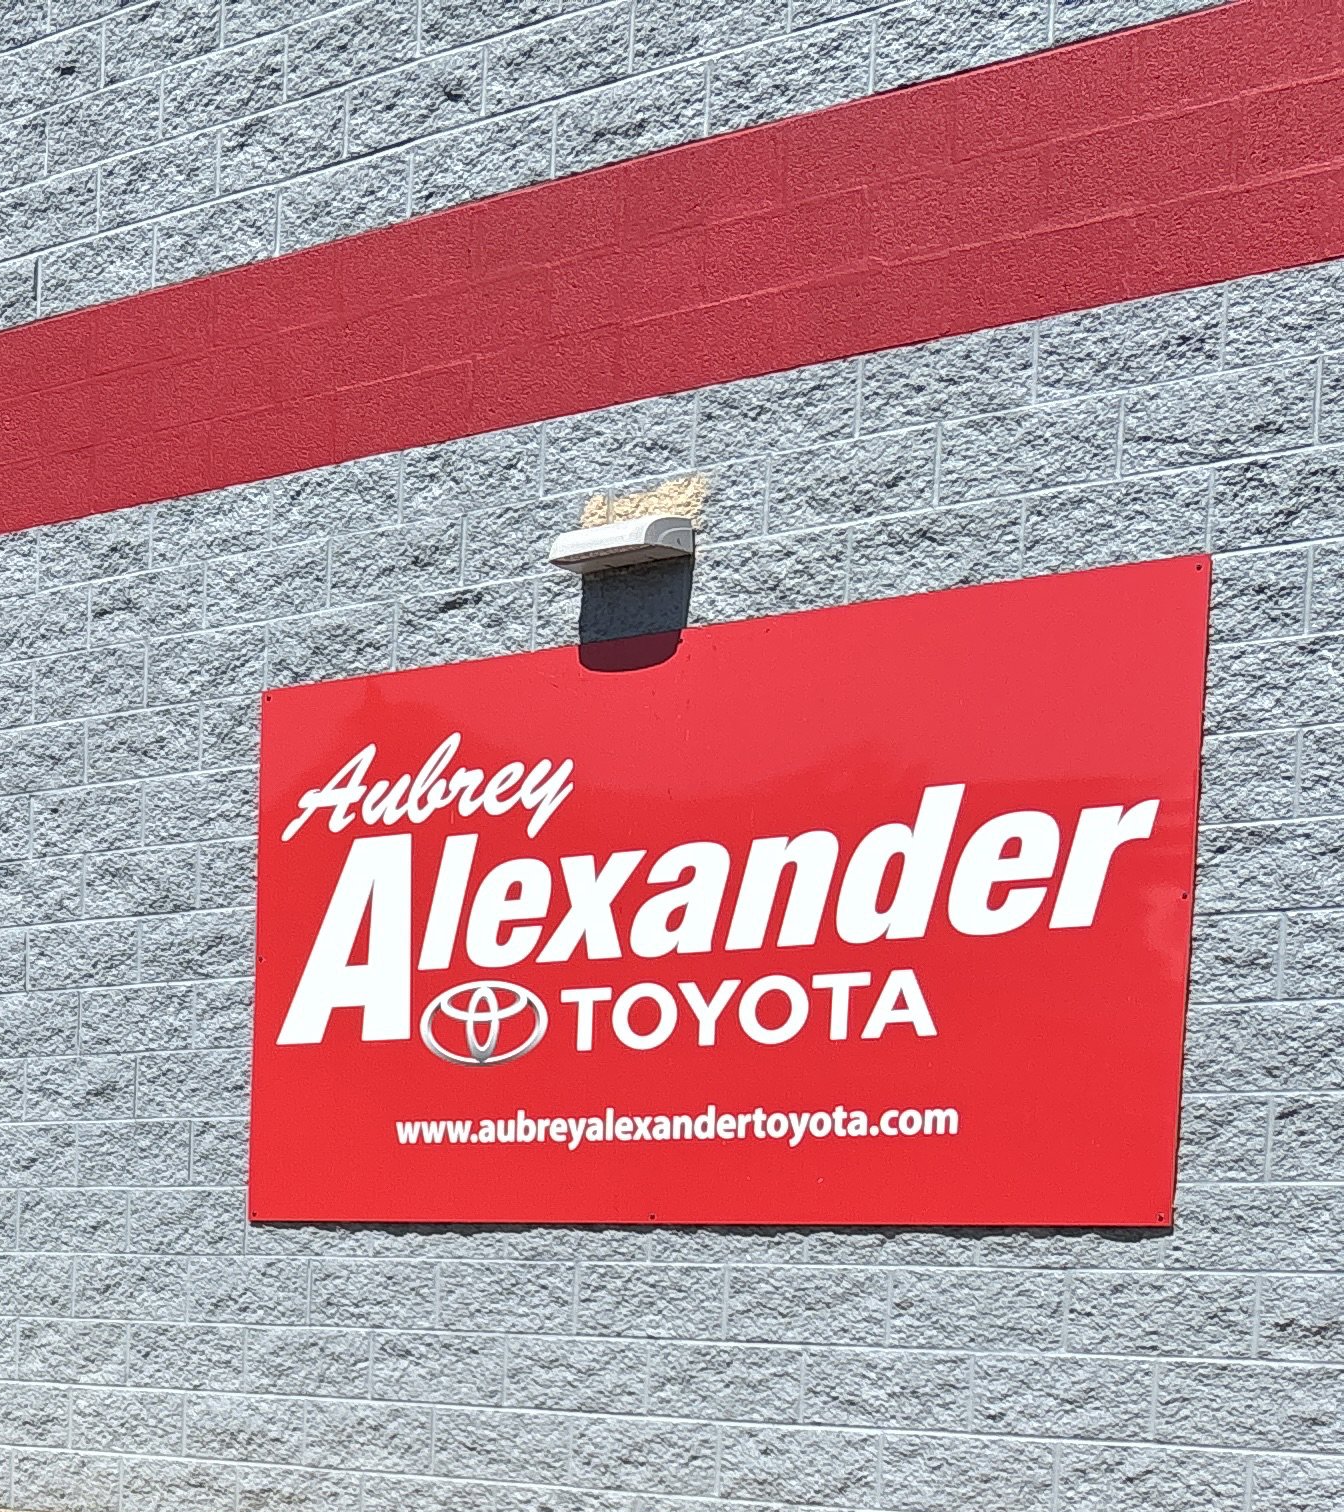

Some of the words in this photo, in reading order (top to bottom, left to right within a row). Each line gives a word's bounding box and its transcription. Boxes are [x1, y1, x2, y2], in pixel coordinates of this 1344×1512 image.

[281, 732, 574, 842] Aubrey
[276, 783, 1160, 1046] Alexander
[560, 969, 938, 1052] TOYOTA
[395, 1104, 959, 1151] www.aubreyalexandertoyota.com
